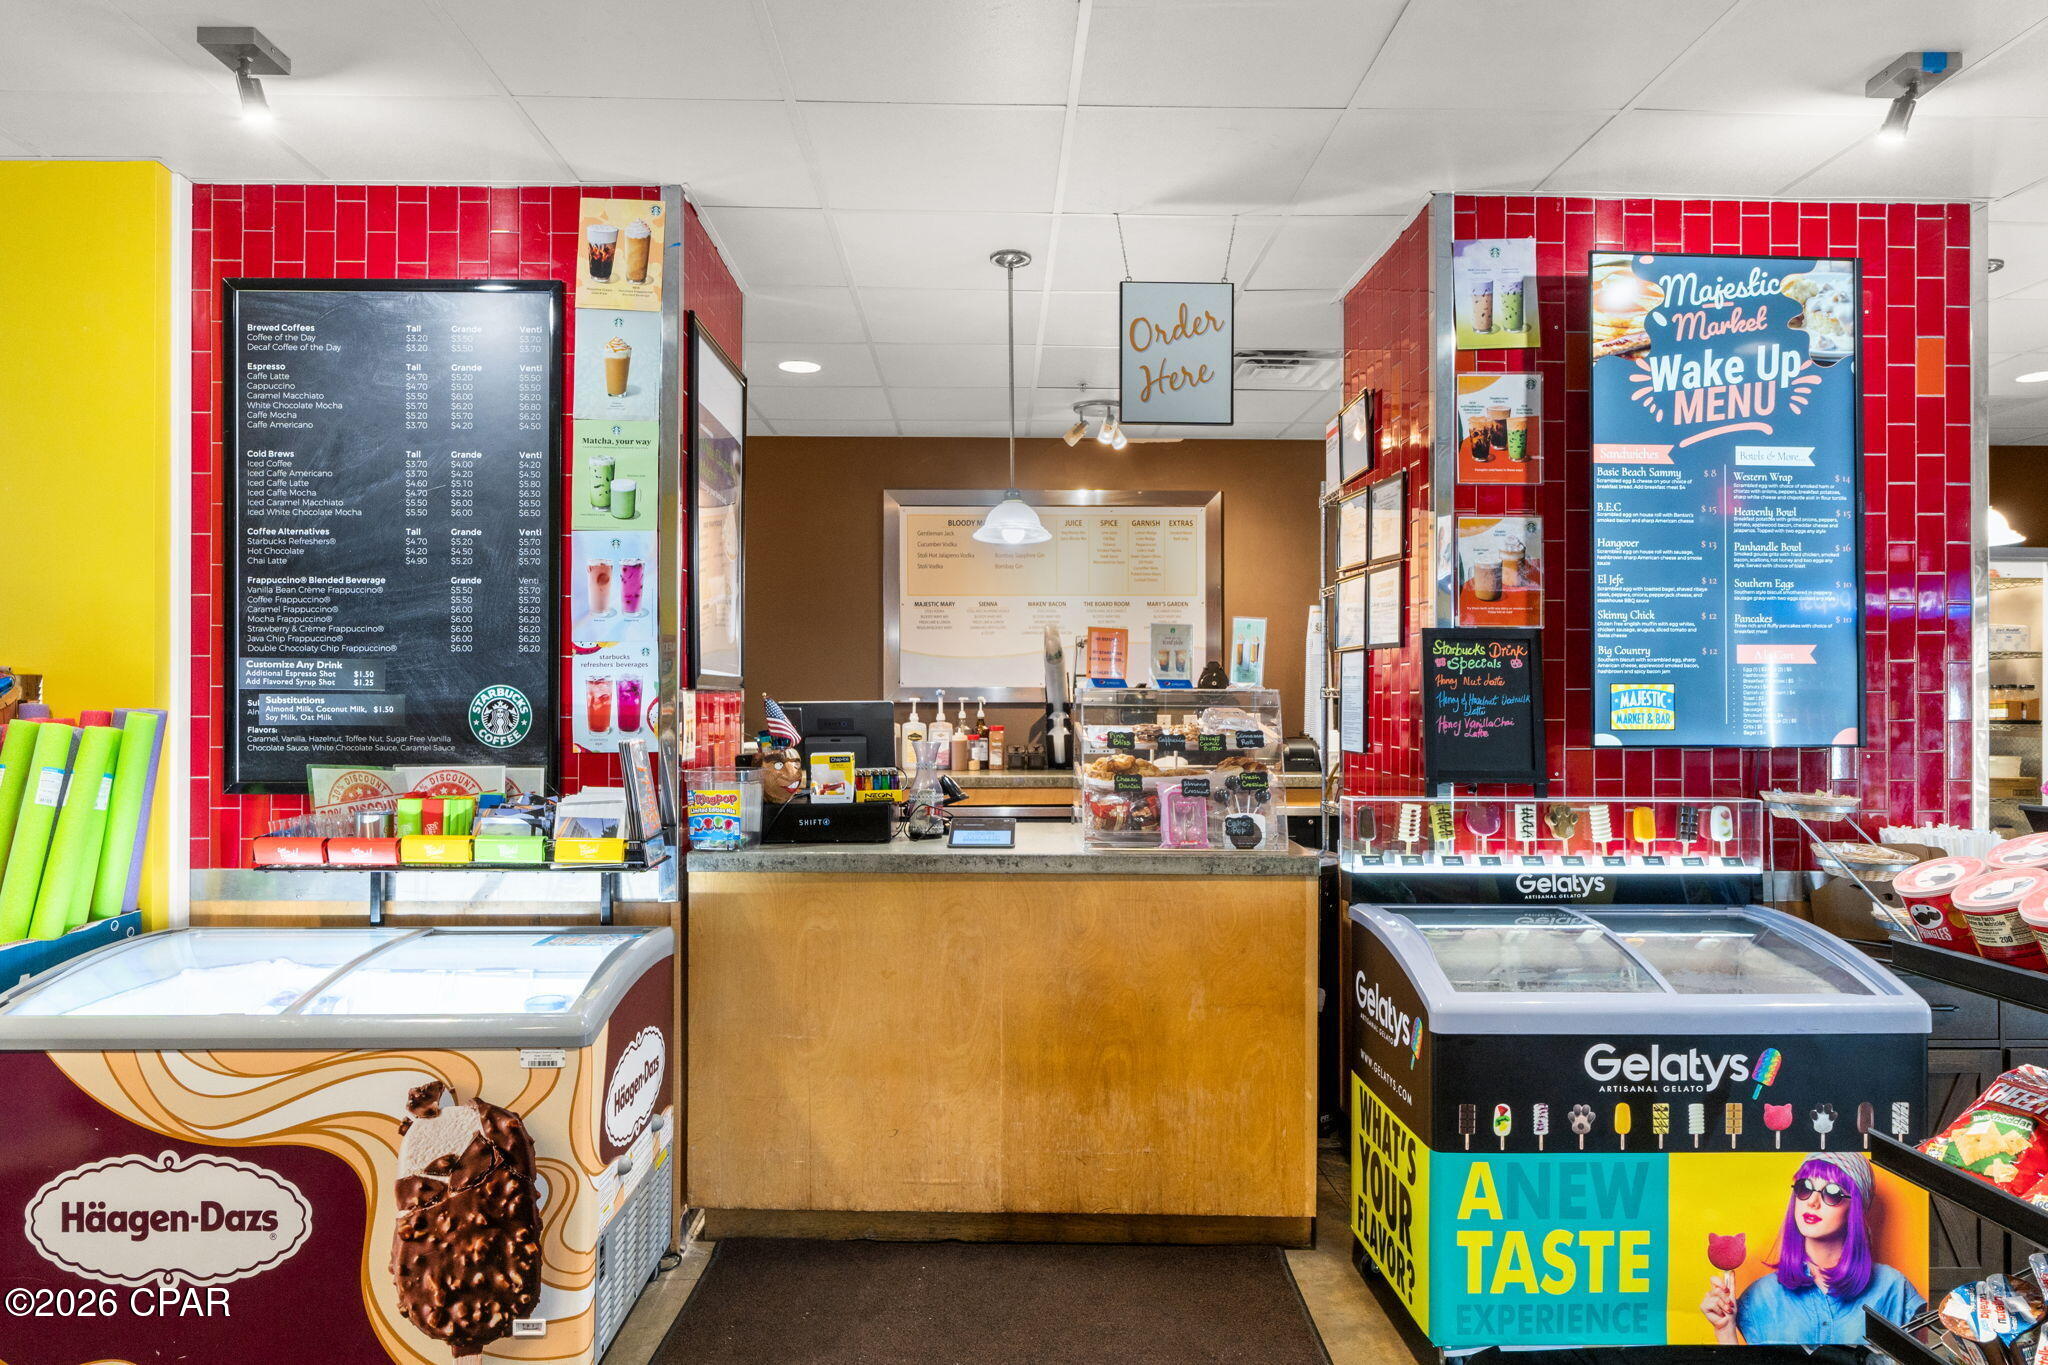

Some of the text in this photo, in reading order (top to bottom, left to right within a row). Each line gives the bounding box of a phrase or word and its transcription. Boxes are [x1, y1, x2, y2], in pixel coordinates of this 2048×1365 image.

[1659, 266, 1783, 310] Majestic
[281, 324, 315, 332] Coffees
[451, 325, 482, 333] Grande
[1129, 302, 1225, 353] Order
[1671, 305, 1768, 342] Market
[301, 334, 316, 342] Day
[406, 334, 428, 343] $3.20
[247, 363, 286, 371] Espresso
[1650, 344, 1801, 392] Wake Up
[246, 372, 268, 380] Caffe
[406, 373, 428, 381] $4.70
[1138, 357, 1215, 403] Here
[246, 382, 296, 391] Cappuccino
[1673, 381, 1776, 425] MENU
[581, 437, 651, 447] Matcha, your way
[268, 450, 295, 458] Brews
[405, 460, 428, 468] $3.70
[1597, 467, 1682, 479] Basic Beach Sammy
[1733, 472, 1793, 484] Western Wrap
[1734, 507, 1797, 518] Heavenly Bowl
[1597, 538, 1640, 550] Hangover
[1734, 542, 1802, 552] Panhandle Bowl
[308, 576, 344, 584] Blended
[345, 576, 386, 585] Beverage
[1597, 574, 1624, 587] El Jefe
[1734, 578, 1795, 590] Southern Eggs
[1597, 610, 1655, 622] Skinny Chick
[1734, 614, 1773, 623] Pancakes
[1432, 639, 1528, 660] Starbucks Drink
[1597, 646, 1651, 657] Big Country
[599, 653, 631, 661] starbucks
[246, 660, 343, 670] Customize Any Drink
[615, 661, 649, 669] beverages
[1447, 656, 1502, 675] Specials
[285, 670, 317, 678] Espresso
[319, 670, 336, 678] Shot
[354, 670, 374, 678] $1.50
[295, 679, 317, 687] Syrup
[1463, 676, 1482, 686] Nut
[265, 696, 325, 704] Substitutions
[472, 687, 529, 714] STARBUCKS
[1620, 690, 1667, 709] MAJESTIC
[316, 705, 348, 713] Coconut
[373, 705, 394, 713] $1.50
[1616, 713, 1671, 724] MARKET & BAR
[478, 729, 522, 745] COFFEE
[346, 774, 388, 793] DISCOUNT
[430, 773, 476, 793] DISCOUNT
[1516, 873, 1605, 898] Gelatys
[1919, 926, 1953, 941] PRINGLES
[1355, 970, 1410, 1048] Gelatys
[1584, 1043, 1749, 1092] Gelatys
[1360, 1048, 1413, 1106] WWW.GELATYS.COM
[614, 1055, 660, 1117] Häagen-Dazs
[1598, 1085, 1704, 1093] ARTISANAL GELATO
[1359, 1085, 1417, 1186] WHAT'S
[1359, 1133, 1413, 1257] YOUR
[1457, 1161, 1649, 1221] A NEW
[60, 1200, 279, 1241] Häagen-Dazs
[1358, 1193, 1416, 1305] FLAVOR?
[1457, 1229, 1650, 1295] TASTE
[1456, 1303, 1649, 1335] EXPERIENCE
